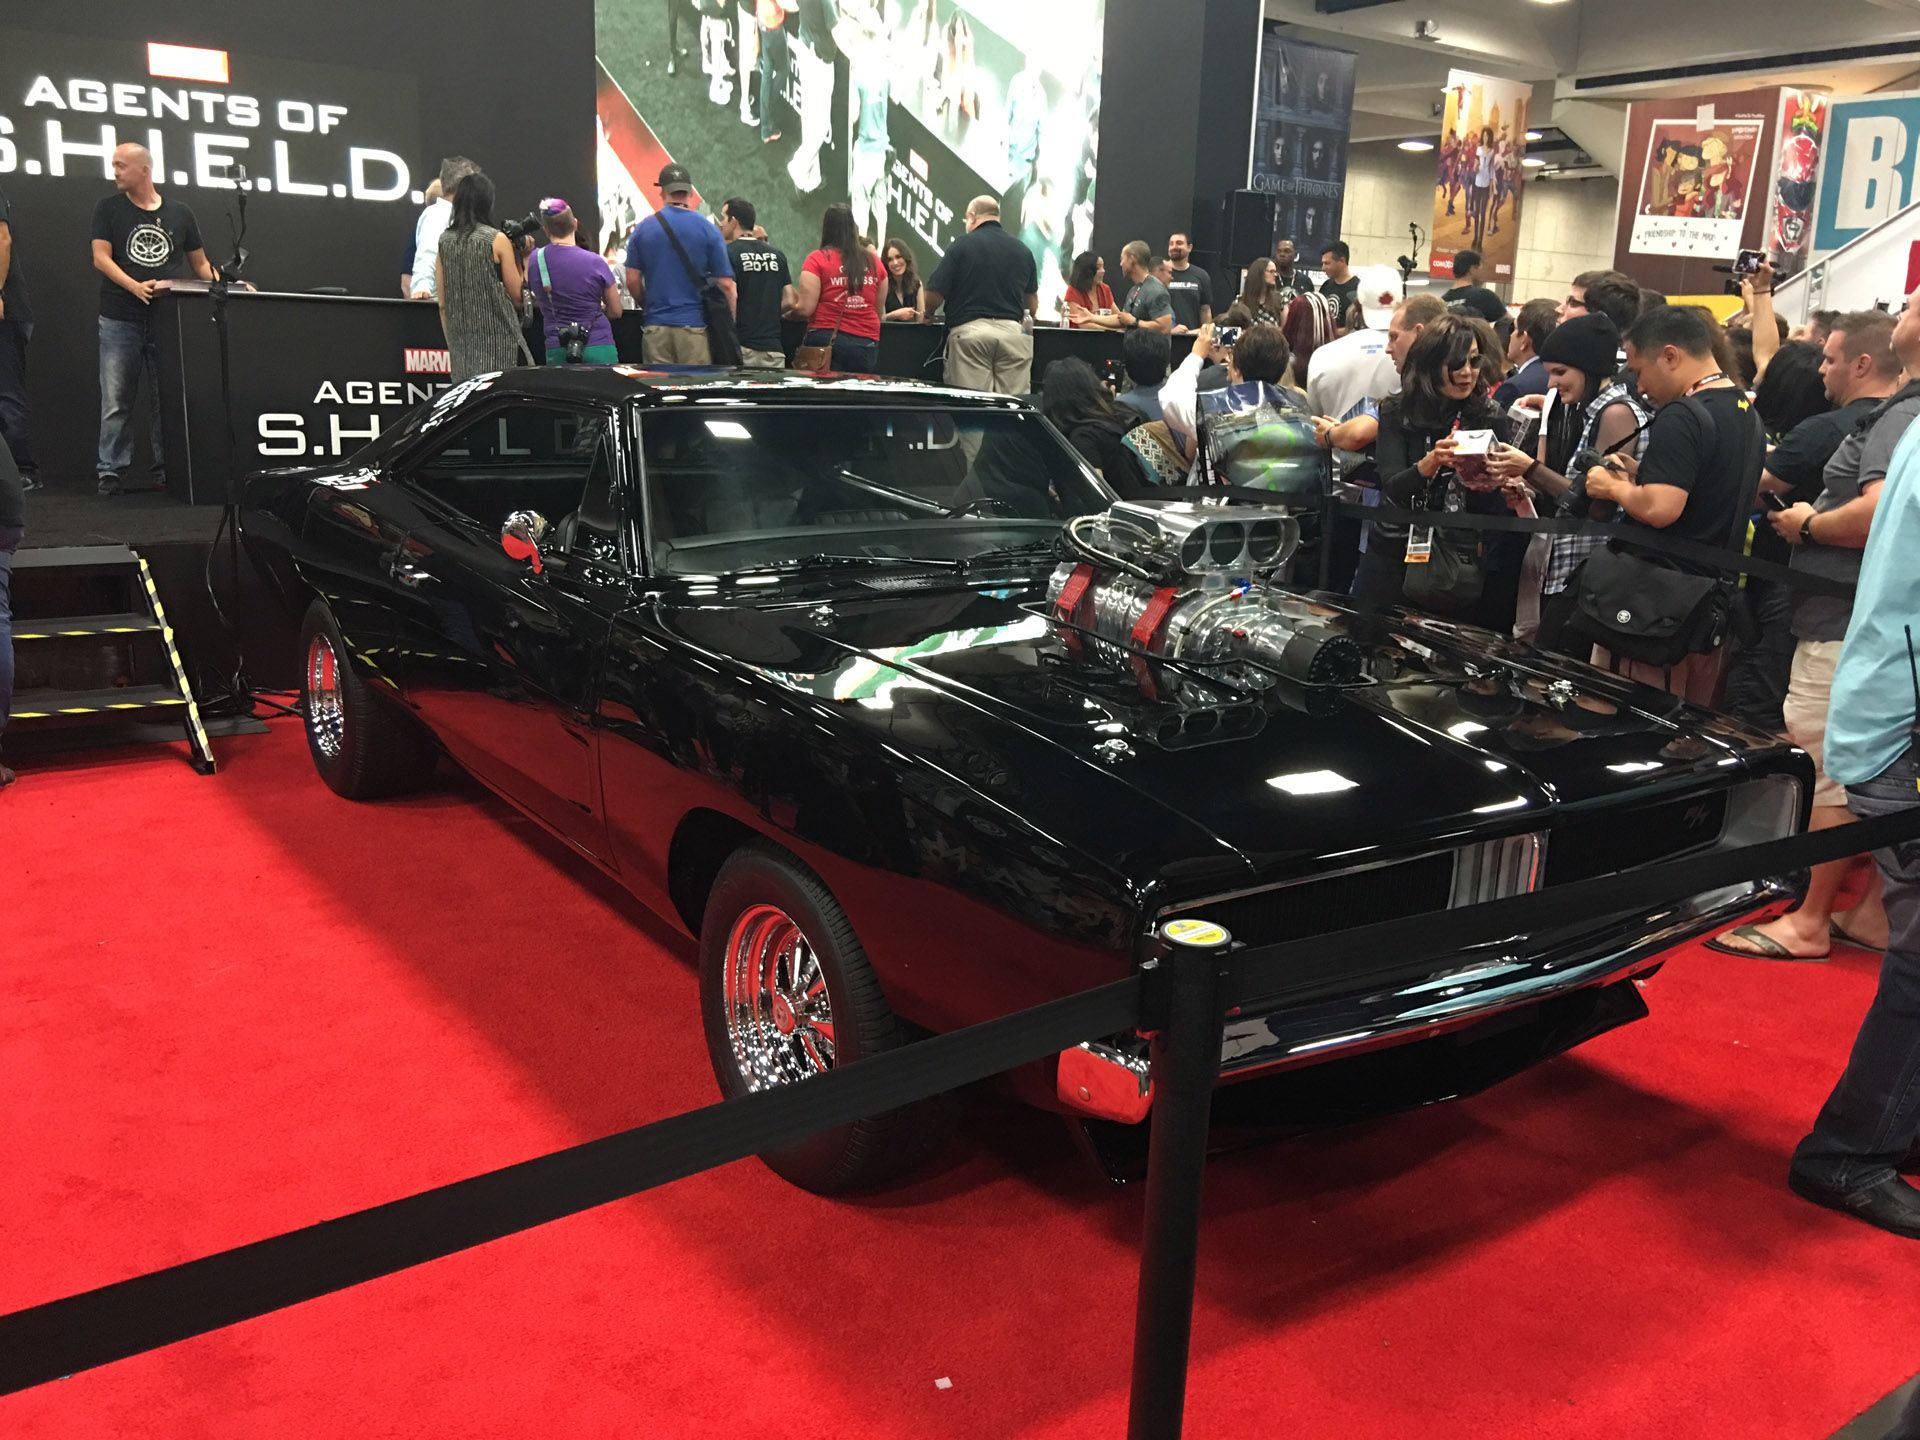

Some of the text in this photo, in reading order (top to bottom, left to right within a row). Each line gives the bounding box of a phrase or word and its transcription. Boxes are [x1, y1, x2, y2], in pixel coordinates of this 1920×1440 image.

[24, 75, 349, 135] AGENTS OF
[0, 115, 425, 205] .H.I.E.L.D.
[1835, 114, 1920, 230] B
[891, 158, 934, 210] GENTS
[1253, 172, 1286, 193] GAME
[1293, 176, 1342, 198] THRONES
[1679, 229, 1687, 238] TO
[1689, 230, 1700, 240] THE
[740, 252, 778, 262] STAFF
[742, 261, 779, 272] 2016
[257, 413, 381, 456] S.H
